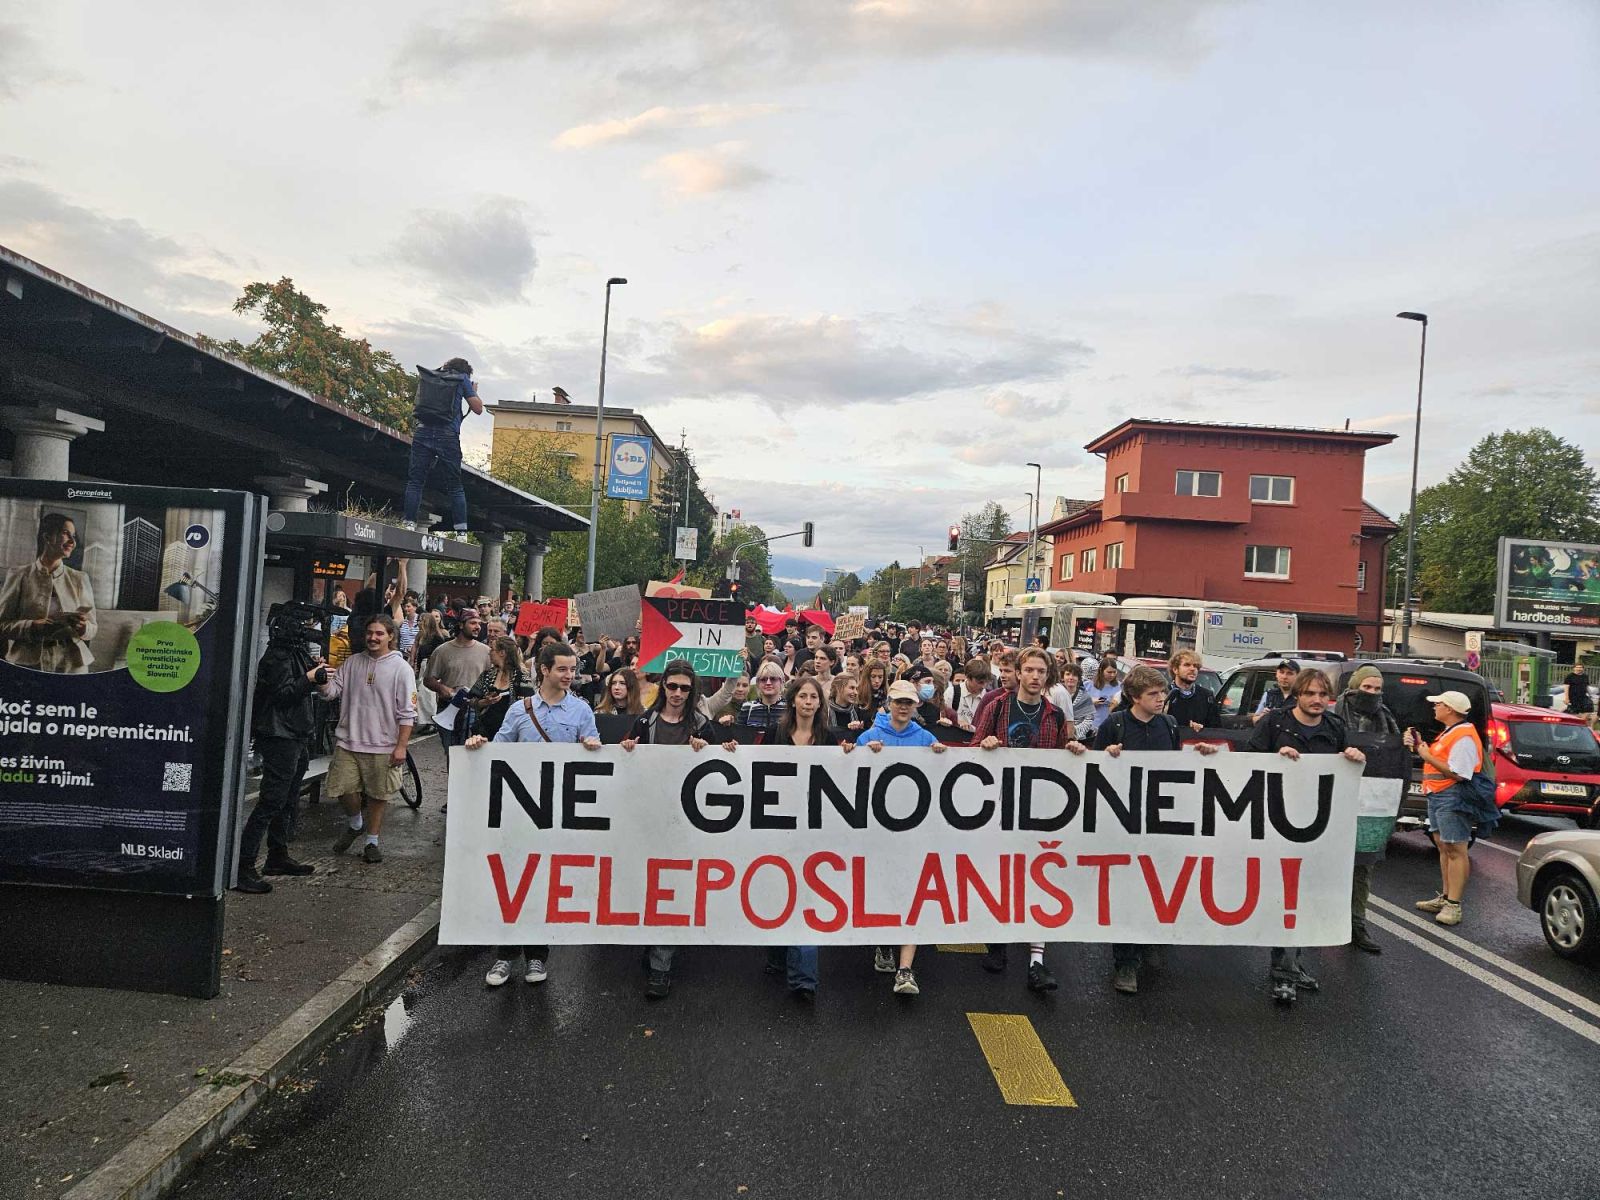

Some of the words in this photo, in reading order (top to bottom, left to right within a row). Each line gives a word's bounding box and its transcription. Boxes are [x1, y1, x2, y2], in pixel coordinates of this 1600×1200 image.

[612, 486, 643, 495] Ljubljana
[533, 609, 562, 624] SMRT
[667, 600, 729, 621] PEACE
[1512, 610, 1572, 624] hardbeats
[698, 627, 722, 646] IN
[1232, 633, 1265, 645] Haier
[35, 703, 75, 719] sem
[80, 702, 97, 719] le
[46, 722, 58, 735] o
[63, 723, 194, 743] nepremičnini.
[20, 755, 65, 770] živim
[37, 773, 48, 784] z
[51, 771, 95, 787] njimi.
[487, 759, 614, 830] NE
[681, 758, 1335, 843] GENOCIDNEMU
[121, 842, 146, 857] NLB
[147, 845, 184, 860] Skladi
